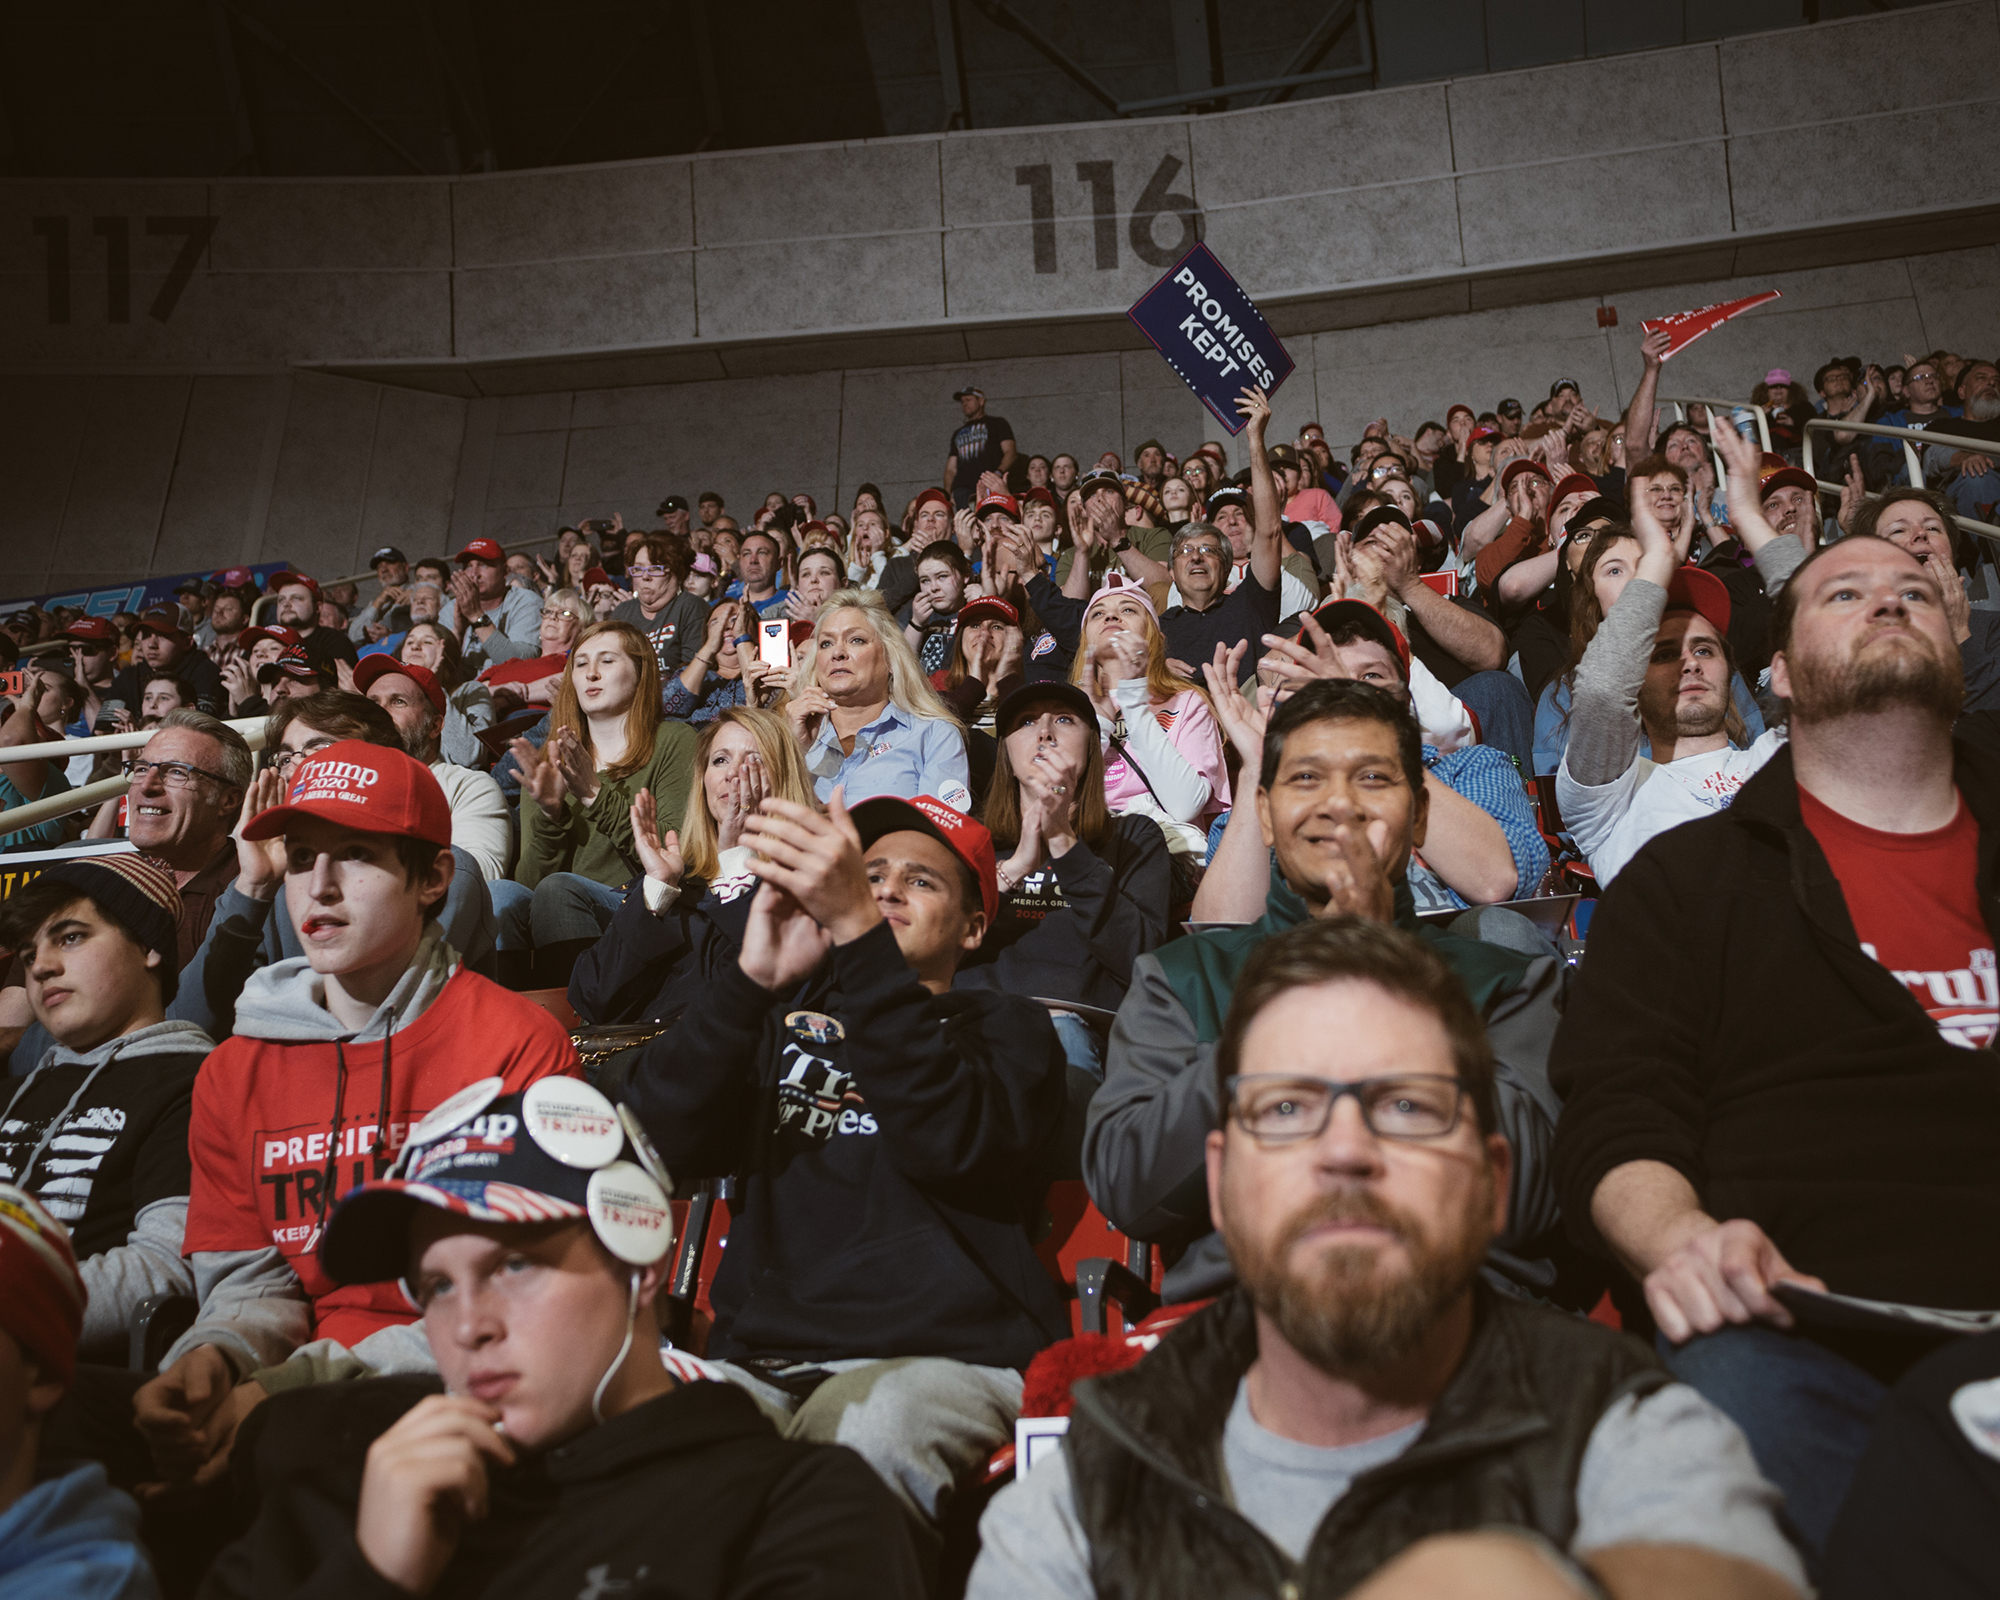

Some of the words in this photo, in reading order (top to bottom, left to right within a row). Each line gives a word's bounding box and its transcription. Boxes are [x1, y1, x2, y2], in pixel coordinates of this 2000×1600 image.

[1015, 153, 1206, 273] 116
[32, 216, 220, 324] 117
[1173, 266, 1275, 390] PROMISES
[1178, 313, 1240, 378] KEPT
[296, 760, 379, 788] Trump
[307, 777, 349, 790] 2020
[302, 789, 336, 801] AMERICA
[338, 791, 368, 804] GREAT
[946, 793, 966, 806] TRUMP
[1010, 897, 1048, 907] MERICA
[1015, 909, 1046, 920] 2020
